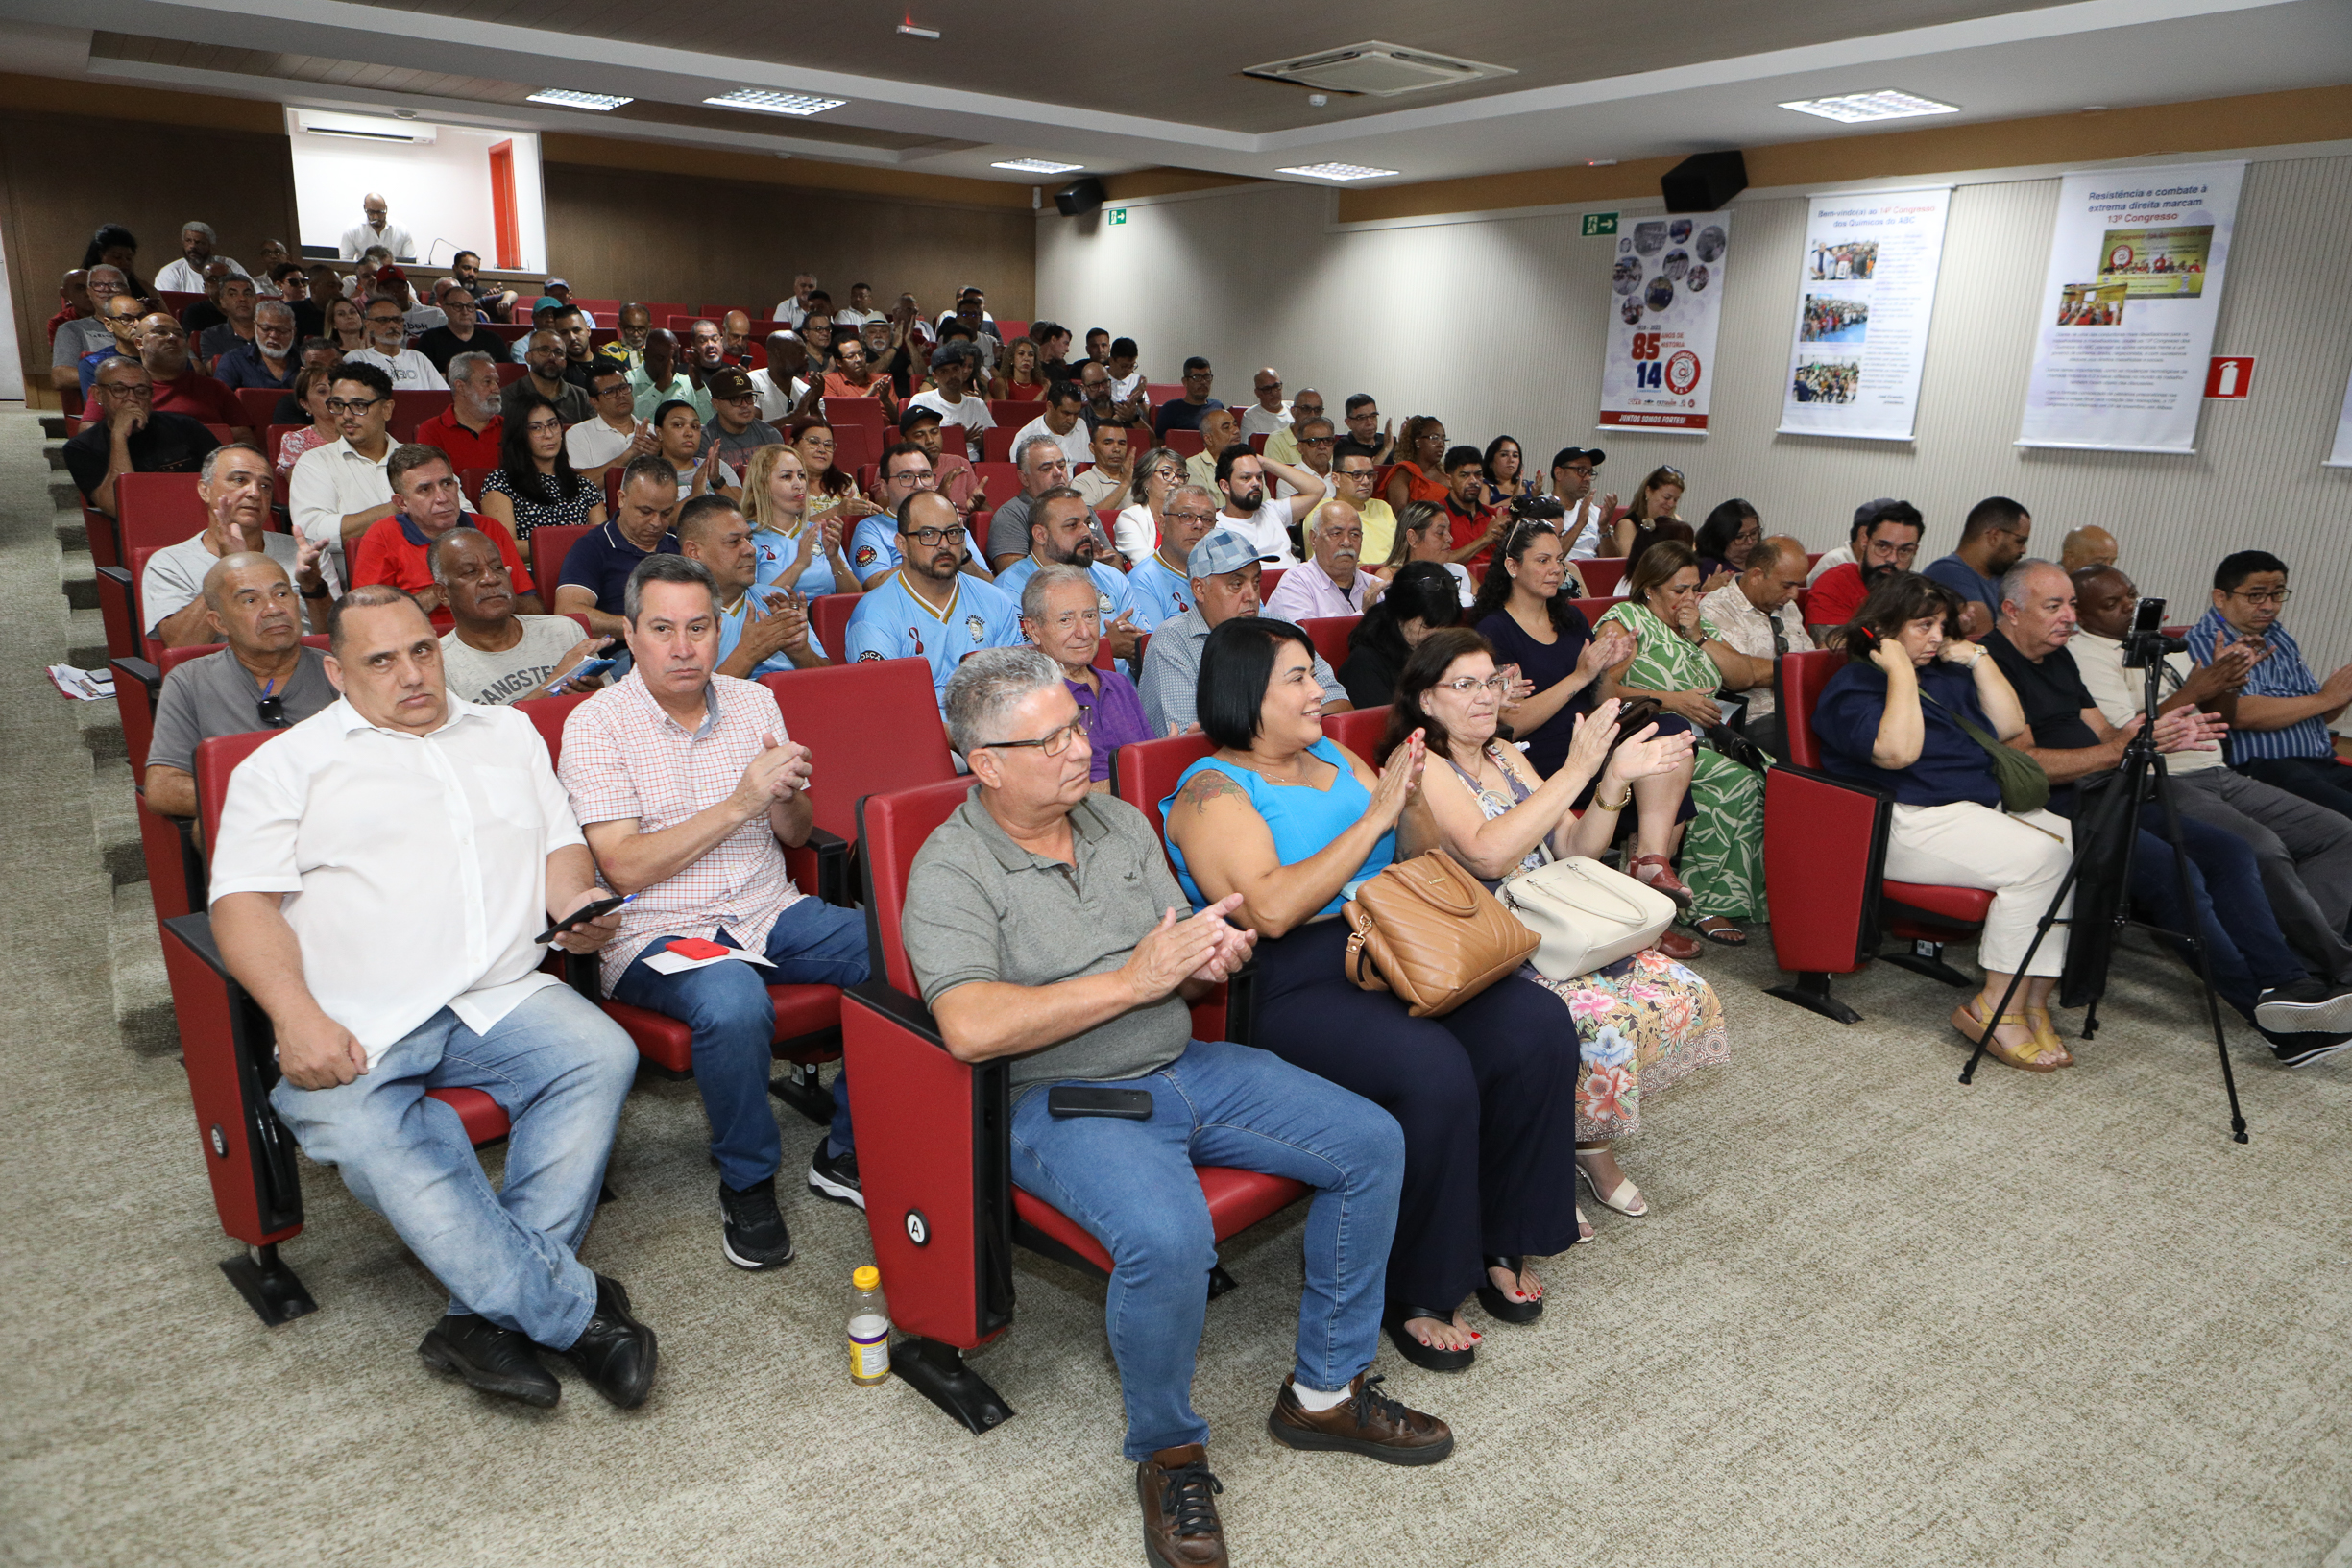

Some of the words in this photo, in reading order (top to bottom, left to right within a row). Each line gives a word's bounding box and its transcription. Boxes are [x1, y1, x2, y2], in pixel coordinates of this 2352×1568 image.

[2088, 189, 2145, 201] Resistência
[2154, 185, 2199, 196] combate
[2200, 183, 2208, 193] à
[1817, 208, 1866, 218] Bem-vindo(a)
[1893, 205, 1936, 215] Congresso
[2087, 202, 2126, 212] extrema
[2128, 200, 2160, 209] direita
[2162, 198, 2203, 208] marcam
[1833, 219, 1847, 228] dos
[1849, 218, 1883, 228] Químicos
[2123, 212, 2179, 223] Congresso
[1631, 332, 1661, 360] 85
[1637, 361, 1662, 388] 14
[1619, 414, 1640, 422] JUNTOS
[1641, 415, 1661, 423] SOMOS
[910, 1220, 922, 1239] A
